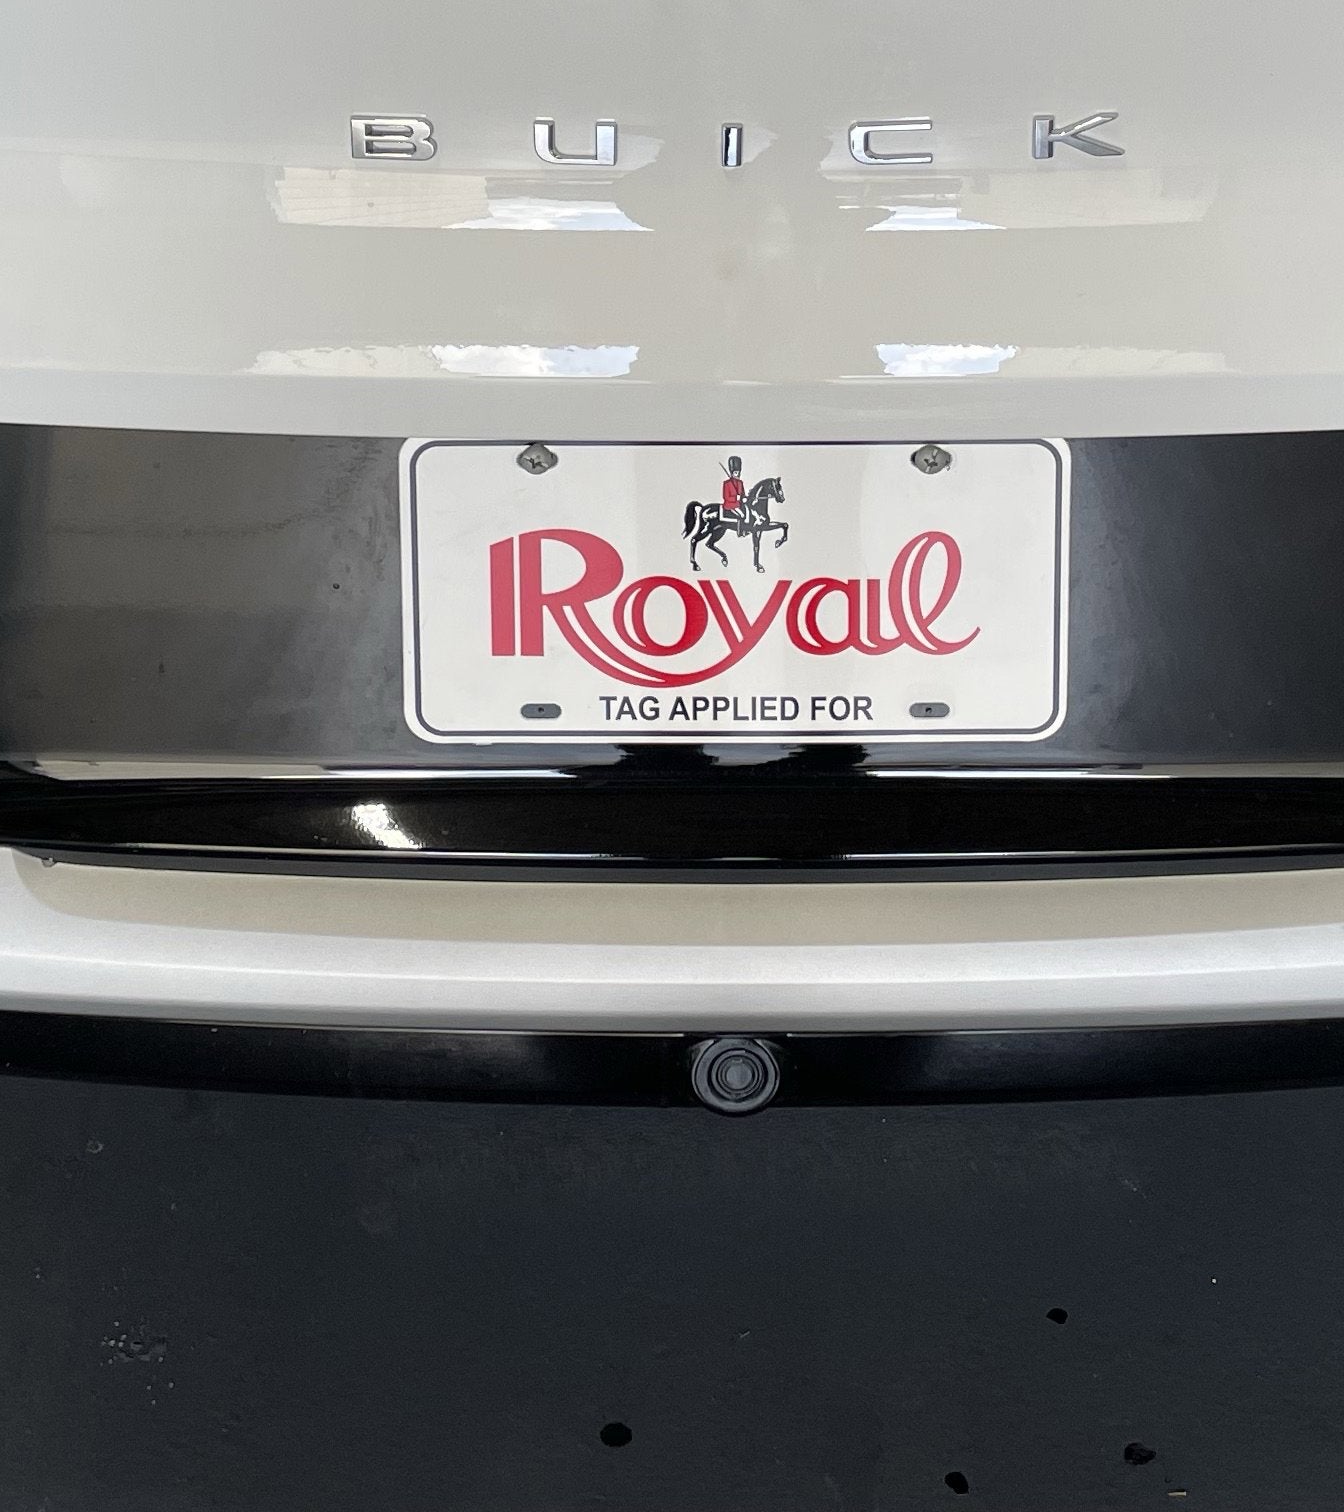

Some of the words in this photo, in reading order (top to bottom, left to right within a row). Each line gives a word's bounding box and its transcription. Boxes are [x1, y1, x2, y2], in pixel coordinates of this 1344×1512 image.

[349, 111, 1127, 168] BUICK
[488, 527, 982, 688] Royal
[599, 695, 660, 721] TAG
[669, 695, 800, 721] APPLIED
[811, 695, 874, 721] FOR
